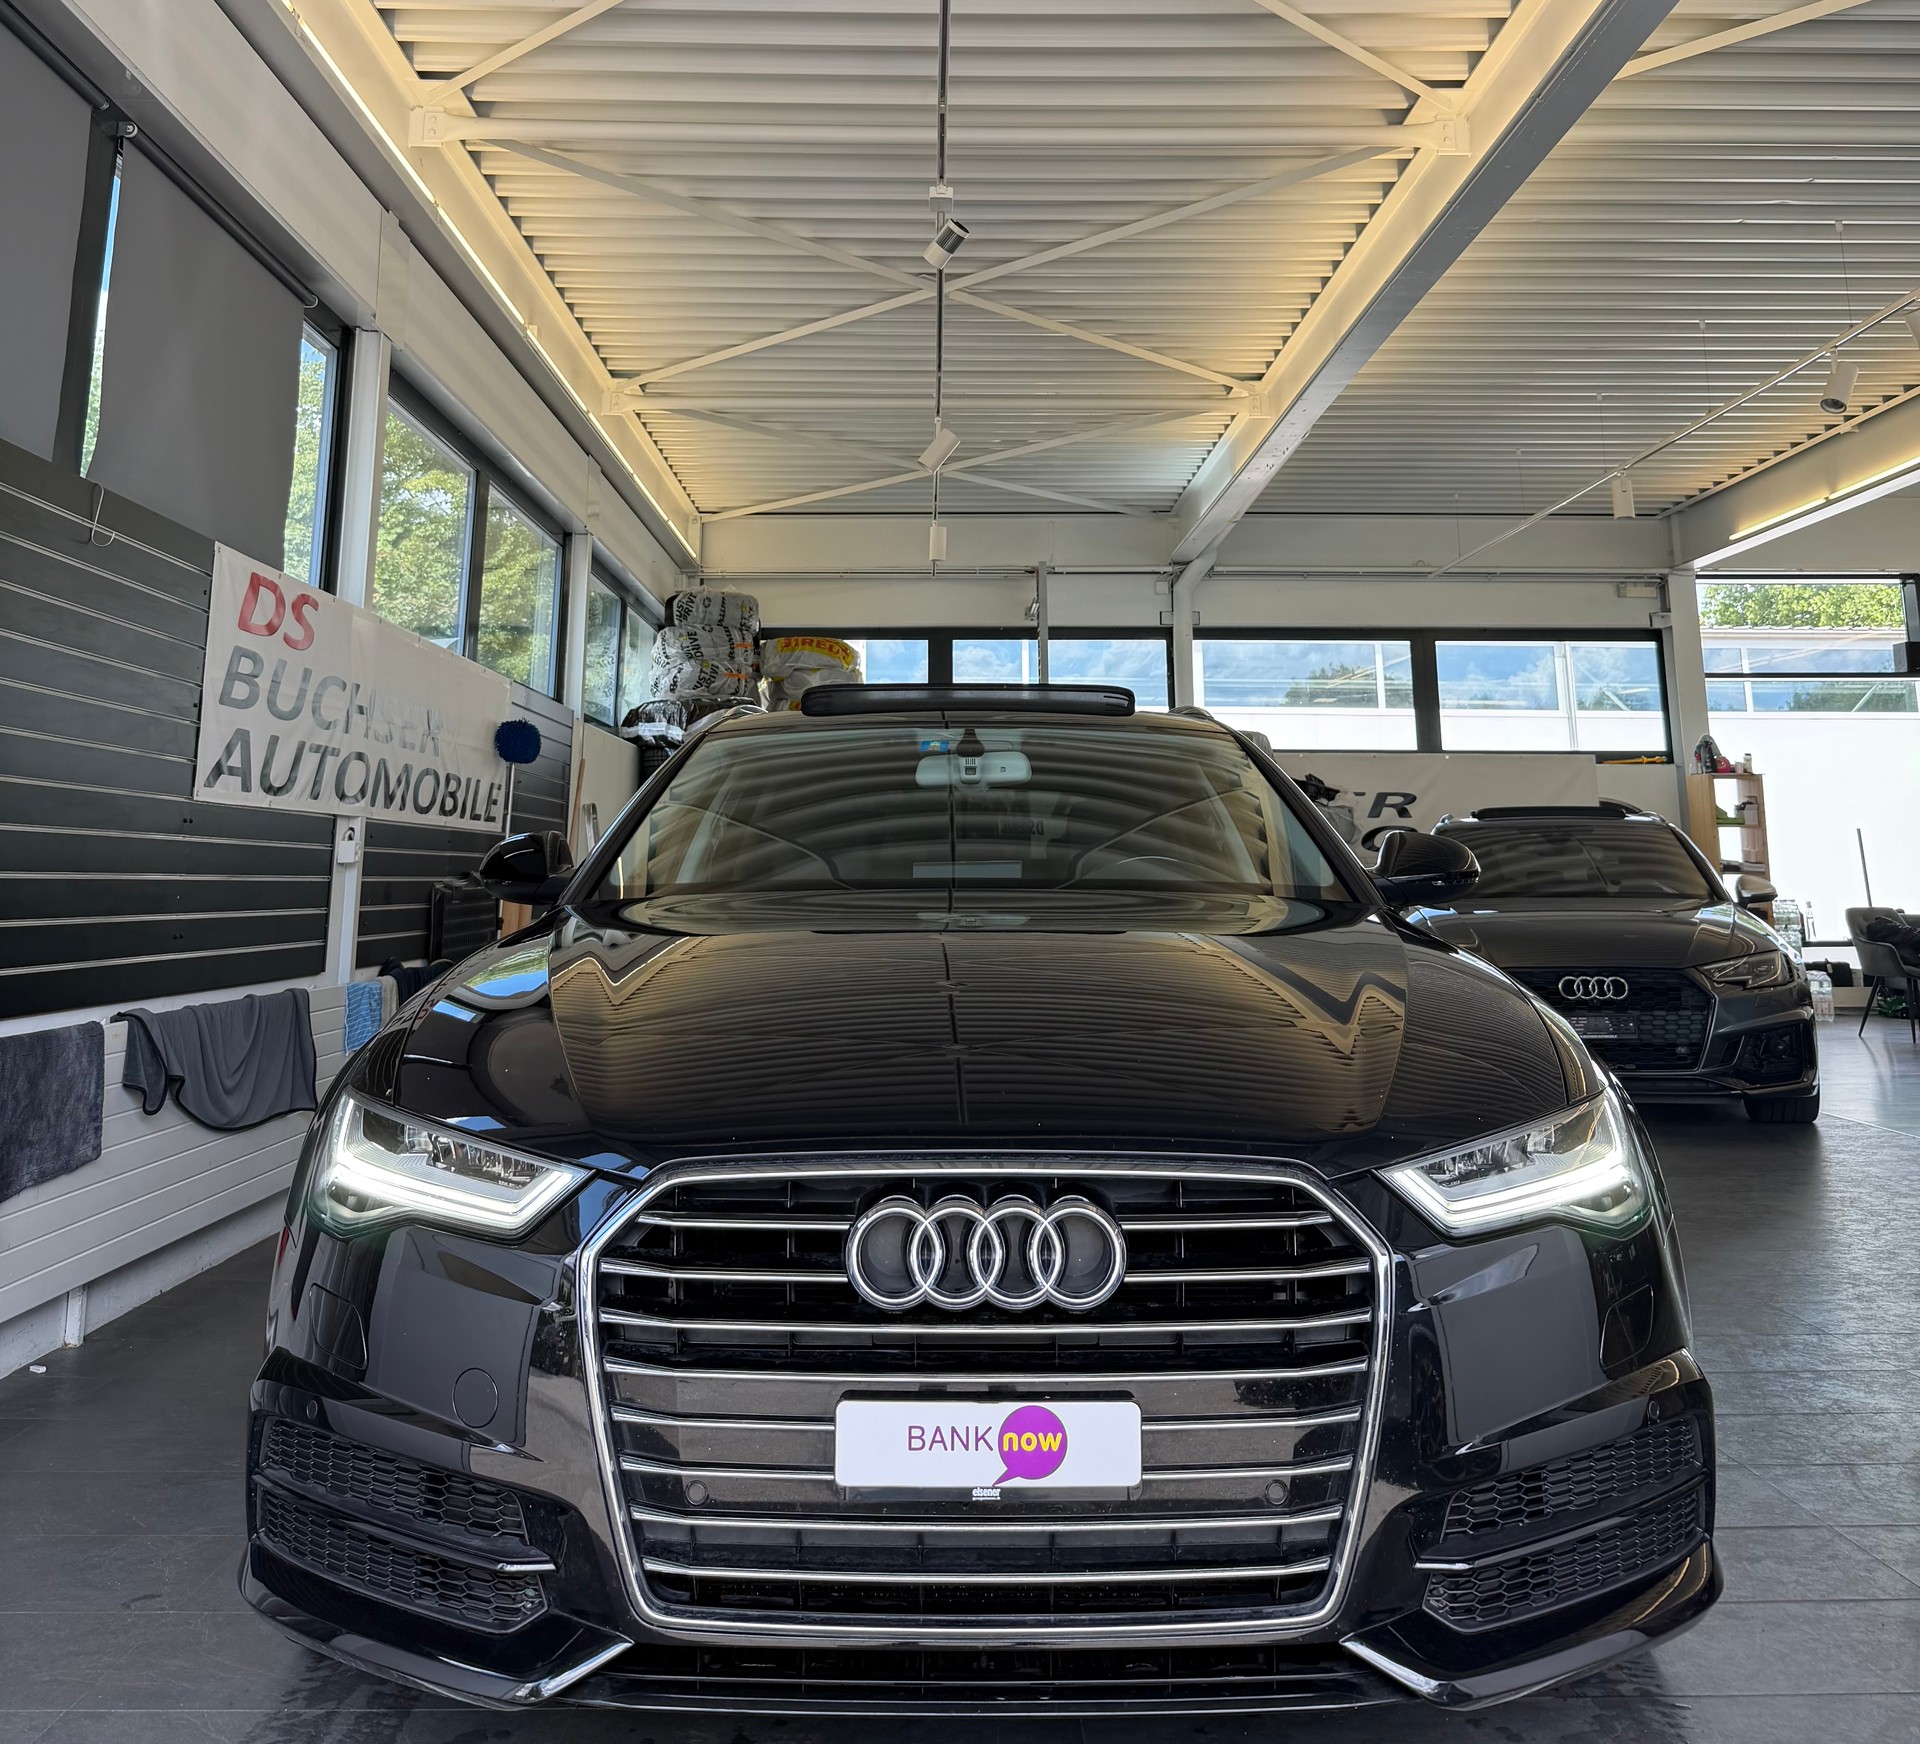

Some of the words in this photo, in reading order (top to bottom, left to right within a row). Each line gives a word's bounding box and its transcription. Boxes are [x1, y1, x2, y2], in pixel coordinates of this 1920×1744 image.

[238, 572, 319, 651] DS
[687, 631, 704, 658] DRIVE
[204, 728, 502, 823] AUTOMOBILE
[907, 1425, 994, 1451] BANK
[1002, 1431, 1063, 1452] now
